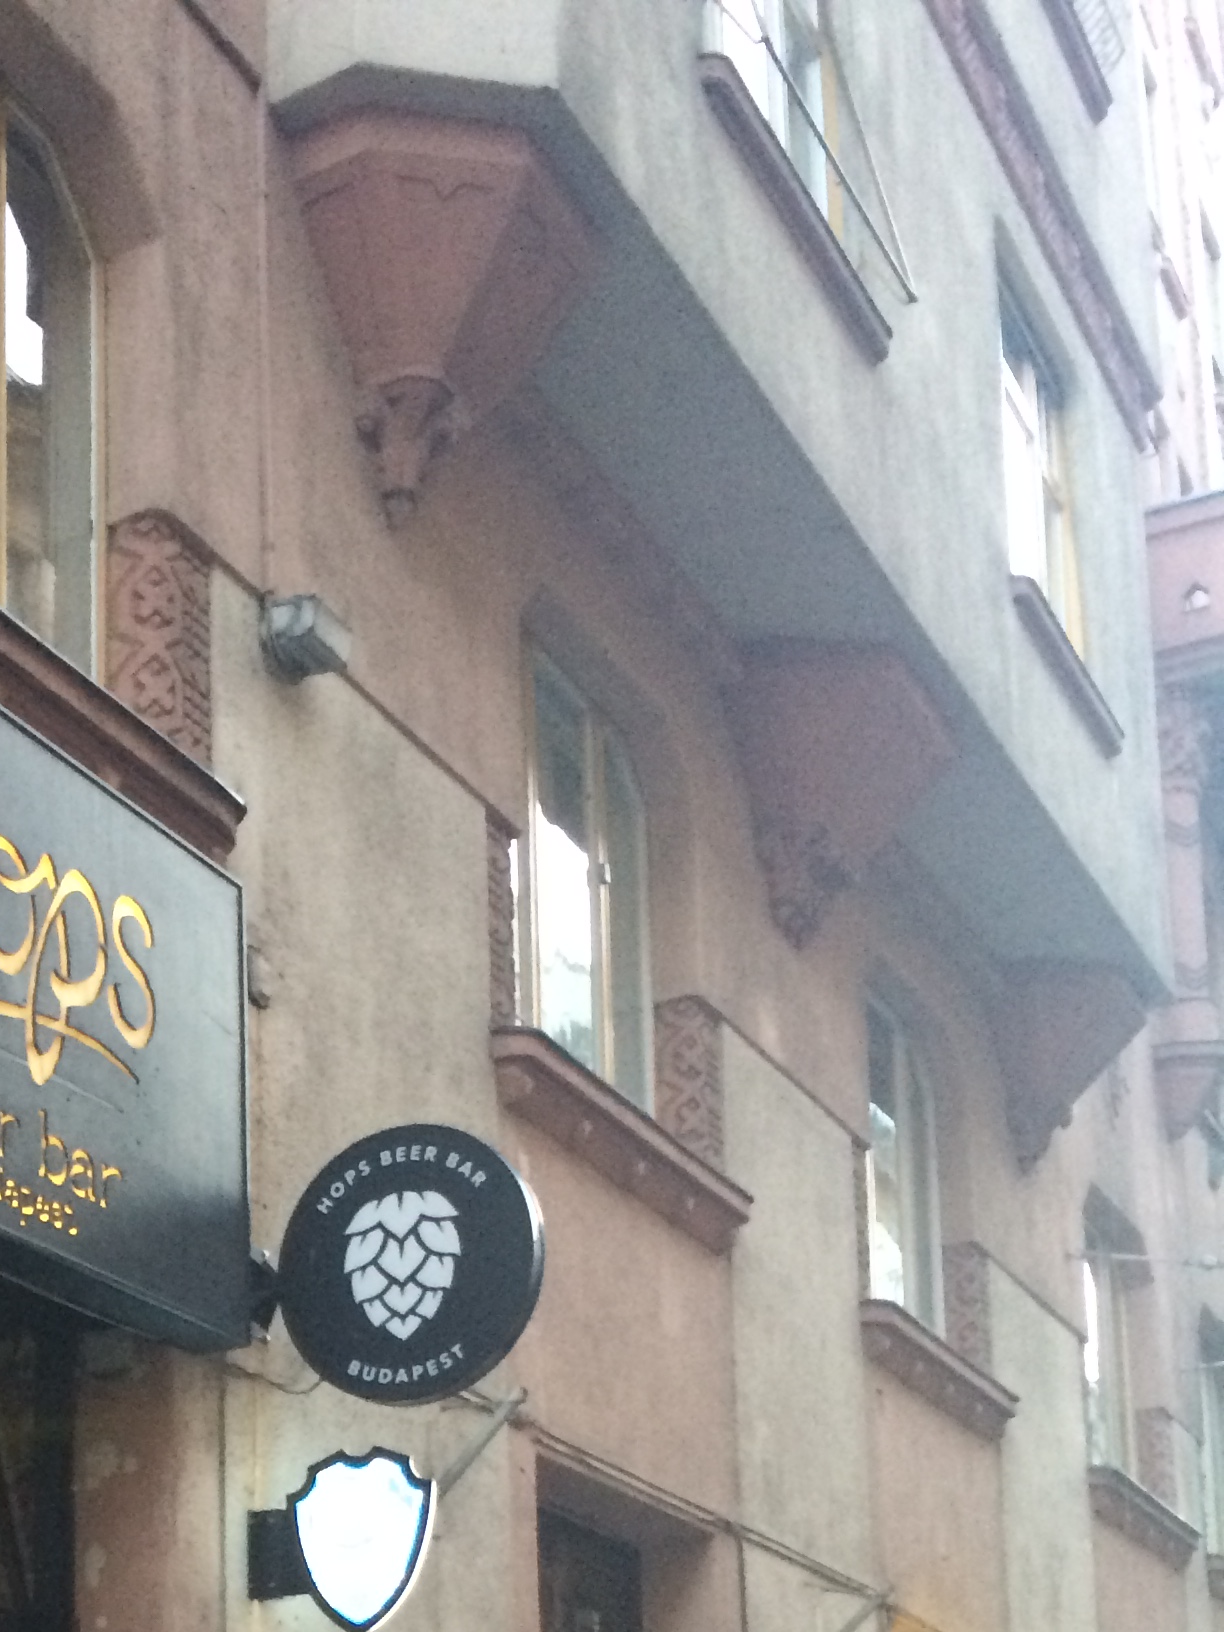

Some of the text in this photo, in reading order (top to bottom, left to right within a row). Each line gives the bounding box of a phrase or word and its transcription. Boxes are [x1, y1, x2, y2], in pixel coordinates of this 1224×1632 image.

[38, 1108, 122, 1209] bar
[316, 1145, 487, 1215] HOPS BEER BAR
[347, 1343, 465, 1385] BUDAPEST
